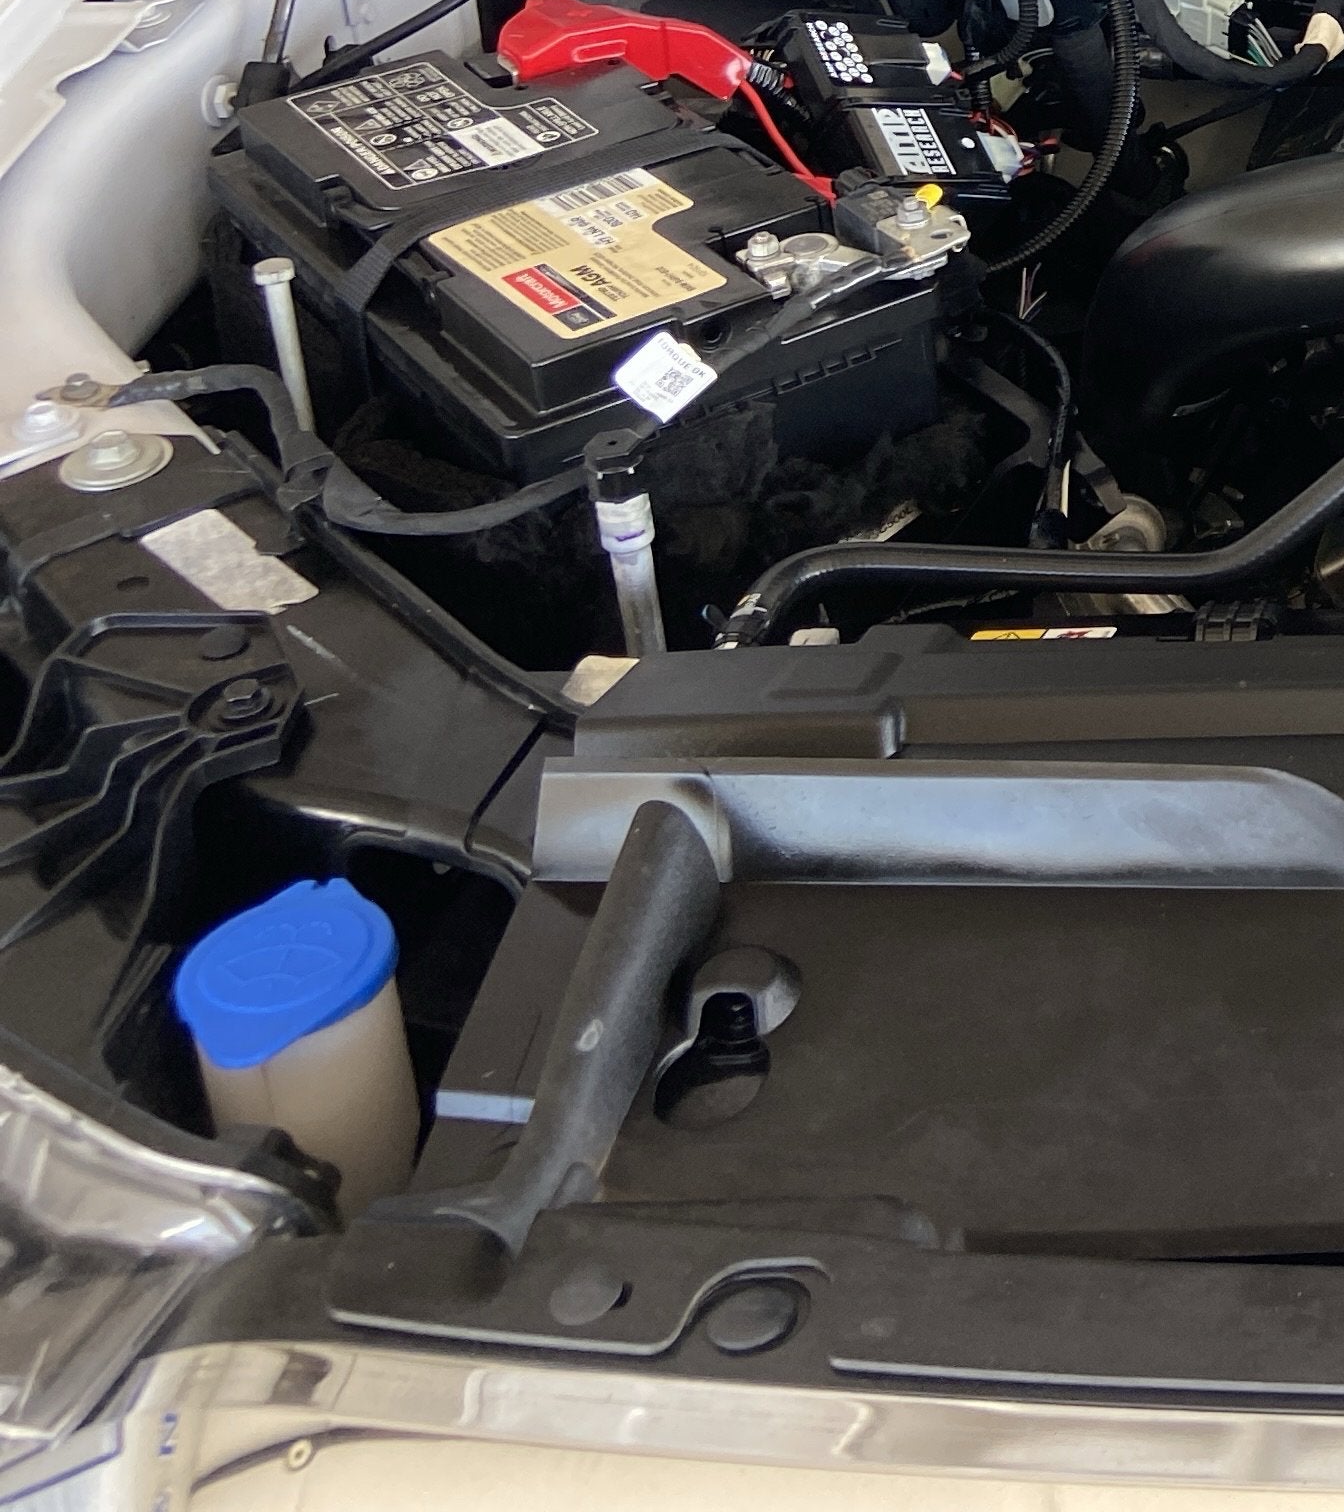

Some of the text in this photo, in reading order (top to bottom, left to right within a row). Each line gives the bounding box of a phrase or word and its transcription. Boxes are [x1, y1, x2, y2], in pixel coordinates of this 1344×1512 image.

[902, 109, 951, 174] RESEARCH
[509, 271, 572, 309] Motorcraft
[567, 263, 612, 288] AGM
[657, 338, 706, 379] TORQUE OK
